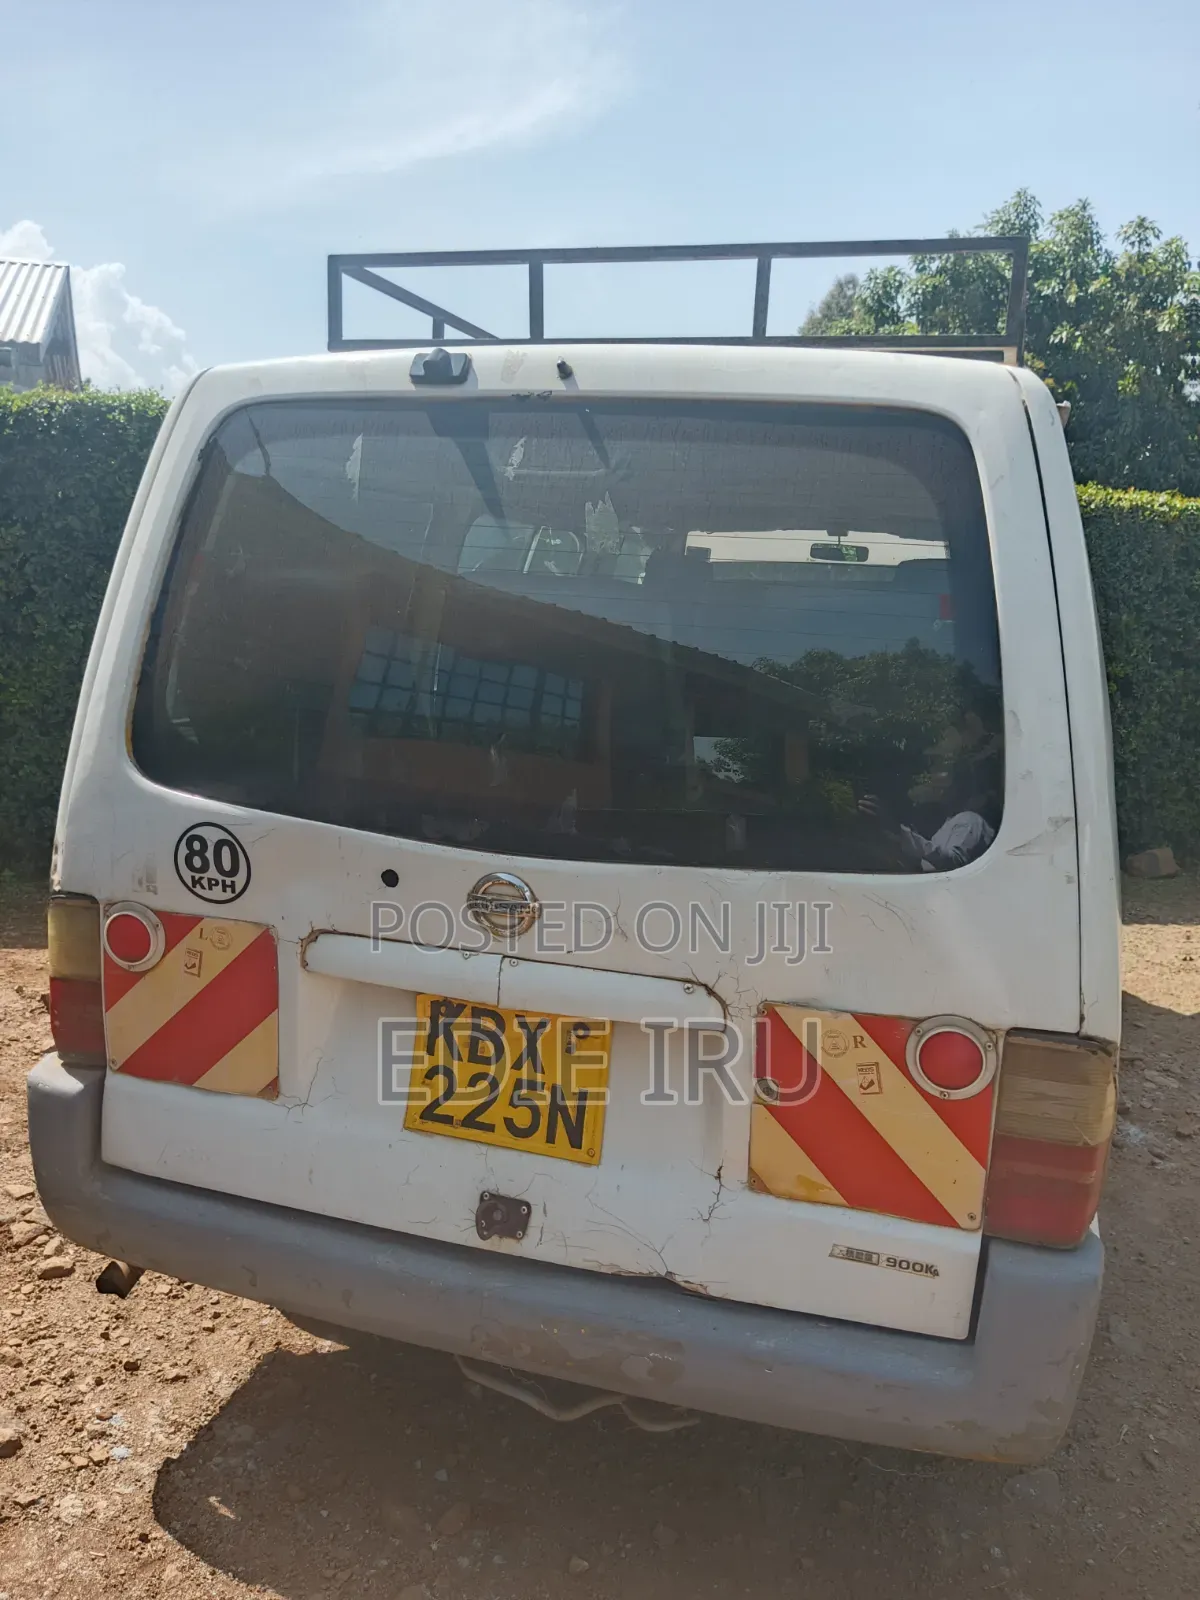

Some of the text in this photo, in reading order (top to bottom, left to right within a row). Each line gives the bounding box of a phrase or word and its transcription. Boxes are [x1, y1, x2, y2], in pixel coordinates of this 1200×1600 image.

[185, 834, 240, 878] 80
[191, 875, 236, 894] KPH
[426, 999, 551, 1075] KBX
[852, 1035, 868, 1049] R
[419, 1064, 588, 1150] 225N
